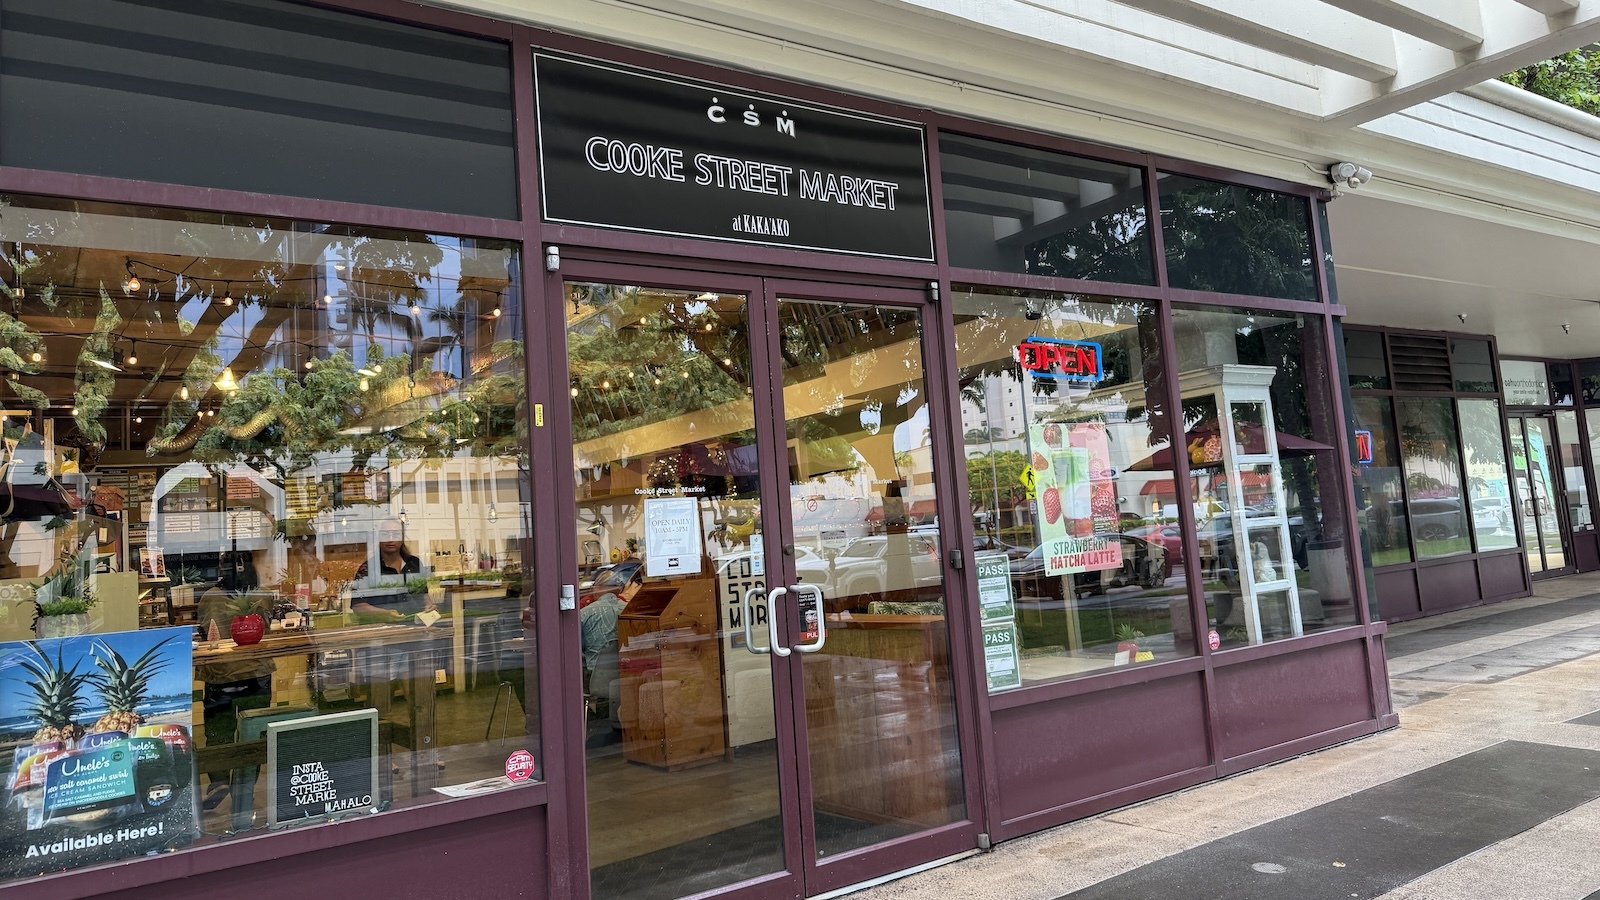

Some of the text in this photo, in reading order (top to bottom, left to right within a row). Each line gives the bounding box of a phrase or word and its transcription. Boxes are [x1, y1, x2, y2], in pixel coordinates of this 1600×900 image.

[585, 136, 898, 210] COOKE STREET MARKET
[732, 214, 790, 237] at KAKA'AKO
[1020, 343, 1097, 374] OPEN
[652, 518, 691, 527] OPEN DAILY
[1053, 537, 1108, 555] STRAWBERRY
[1050, 550, 1116, 569] MATCHA LATTE
[979, 564, 1004, 576] PASS
[806, 631, 819, 639] PUL
[985, 632, 1010, 644] PASS
[150, 727, 181, 738] Uncle's
[62, 756, 110, 776] Uncle's
[292, 762, 325, 775] INSTA
[507, 761, 533, 774] SECURITY
[60, 780, 75, 790] salt
[76, 772, 107, 787] caramel
[109, 769, 129, 781] swirl
[290, 770, 329, 785] @COOKE
[48, 780, 126, 800] ICE CREAM SANDWICH
[290, 780, 334, 796] STREET
[295, 789, 337, 806] MARKE
[325, 795, 371, 812] MAHALO
[25, 822, 164, 858] Available Here!
